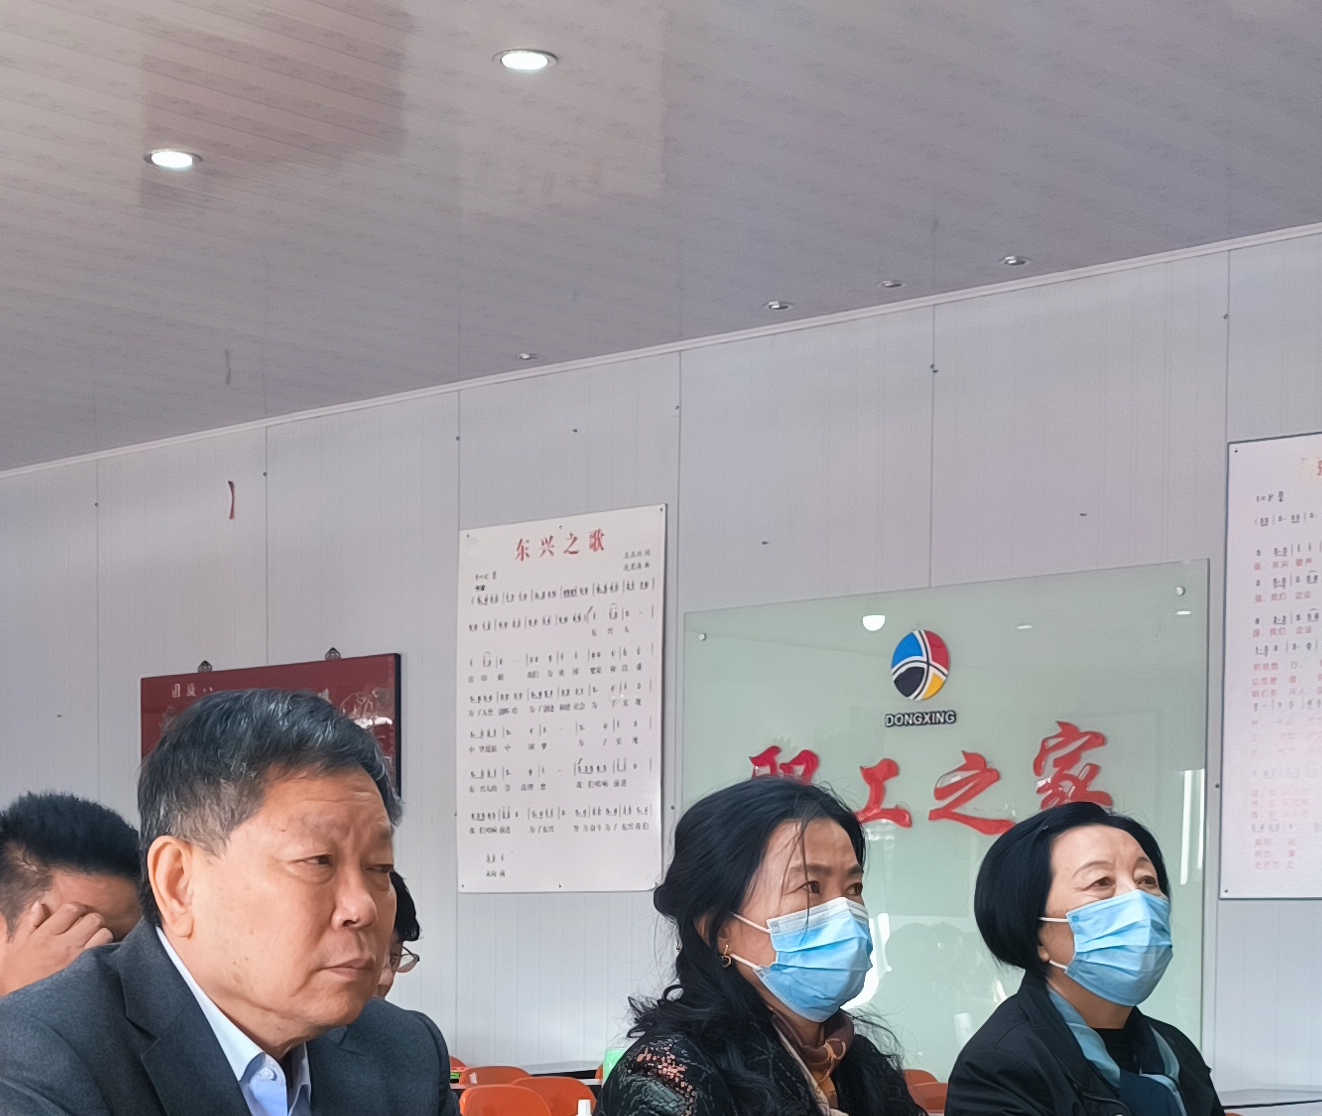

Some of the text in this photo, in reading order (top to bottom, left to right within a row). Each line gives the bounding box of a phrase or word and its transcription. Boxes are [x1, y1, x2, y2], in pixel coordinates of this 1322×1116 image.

[514, 528, 605, 562] 东兴之歌
[885, 710, 956, 727] DONGXING
